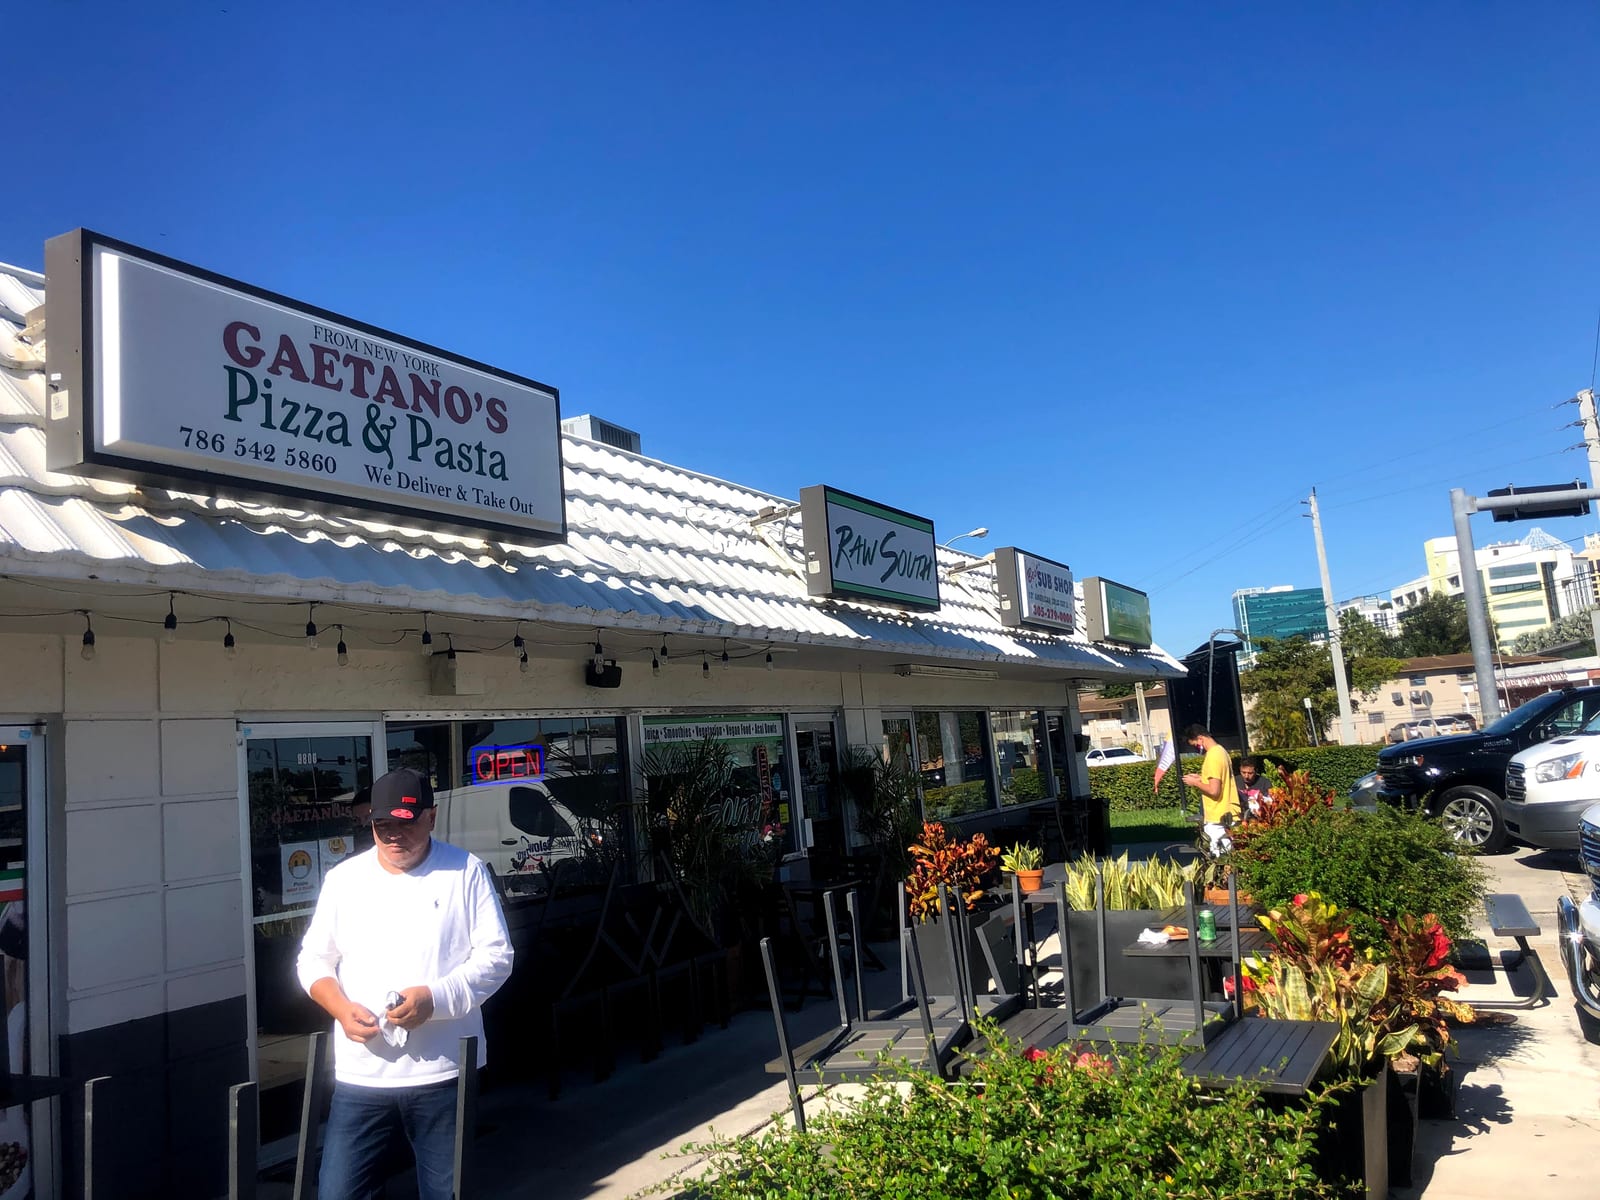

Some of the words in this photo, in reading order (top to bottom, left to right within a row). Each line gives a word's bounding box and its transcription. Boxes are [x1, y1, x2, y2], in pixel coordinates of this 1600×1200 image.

[313, 325, 359, 353] FROM
[363, 341, 398, 363] NEW
[402, 353, 440, 377] YORK
[222, 321, 508, 434] GAETANO'S
[223, 365, 352, 447] Pizza
[362, 403, 396, 469] &
[406, 413, 509, 481] Pasta
[179, 426, 225, 454] 786
[234, 437, 276, 463] 542
[285, 447, 337, 474] 5860
[364, 464, 392, 487] We
[397, 471, 452, 498] Deliver
[456, 484, 468, 501] &
[471, 487, 506, 510] Take
[509, 496, 534, 516] Out
[1037, 571, 1052, 589] SUB
[1054, 576, 1073, 595] SHOP
[644, 728, 659, 740] Juice
[663, 726, 692, 739] Smoothies
[726, 724, 740, 737] Vegan
[740, 723, 751, 735] Food
[476, 752, 540, 780] OPEN
